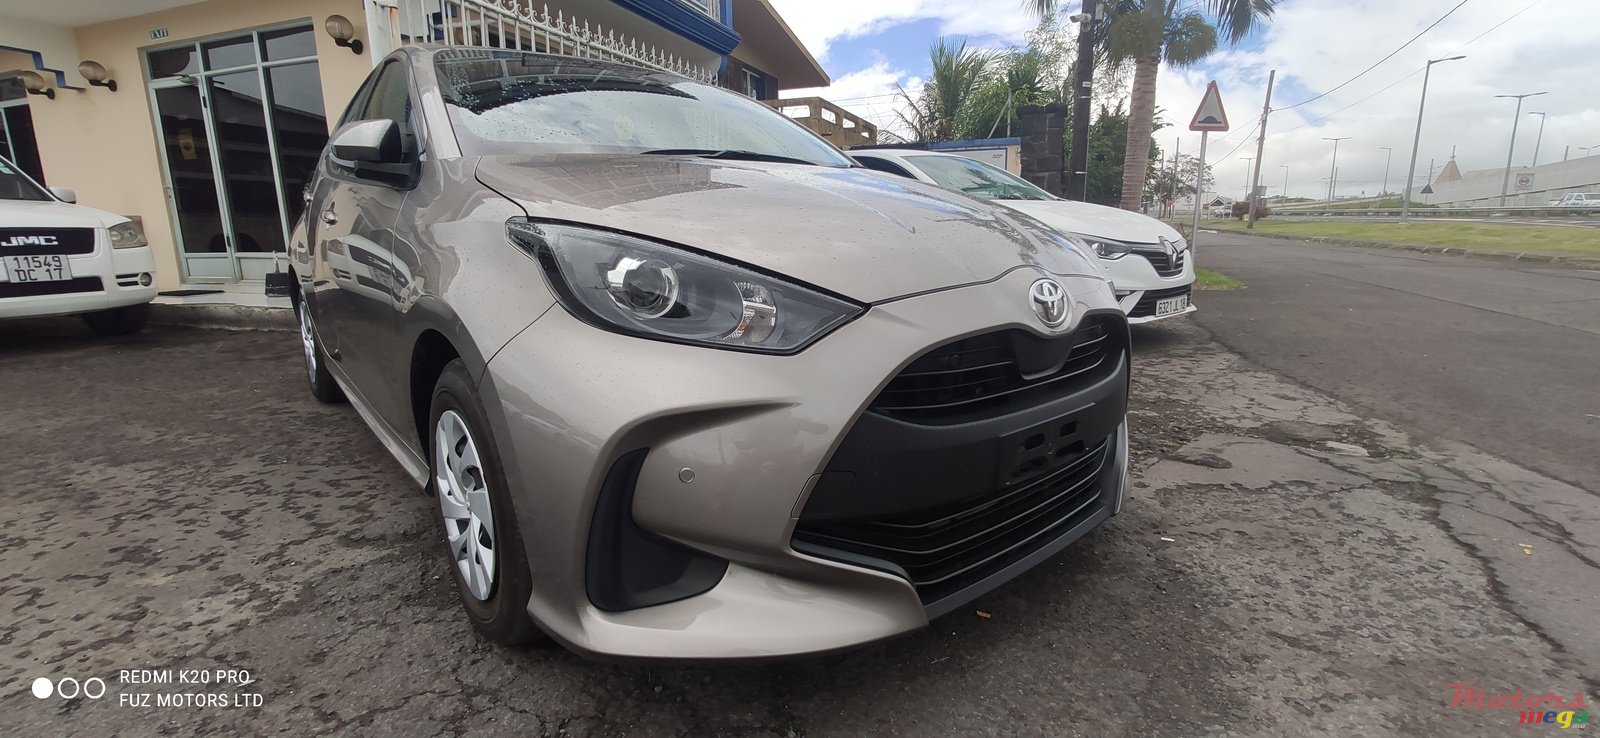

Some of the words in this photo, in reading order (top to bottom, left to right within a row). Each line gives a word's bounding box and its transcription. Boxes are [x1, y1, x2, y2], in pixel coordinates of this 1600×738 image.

[1, 236, 58, 246] JMC
[13, 256, 63, 268] 11549
[15, 268, 38, 281] DC
[45, 268, 63, 280] 17
